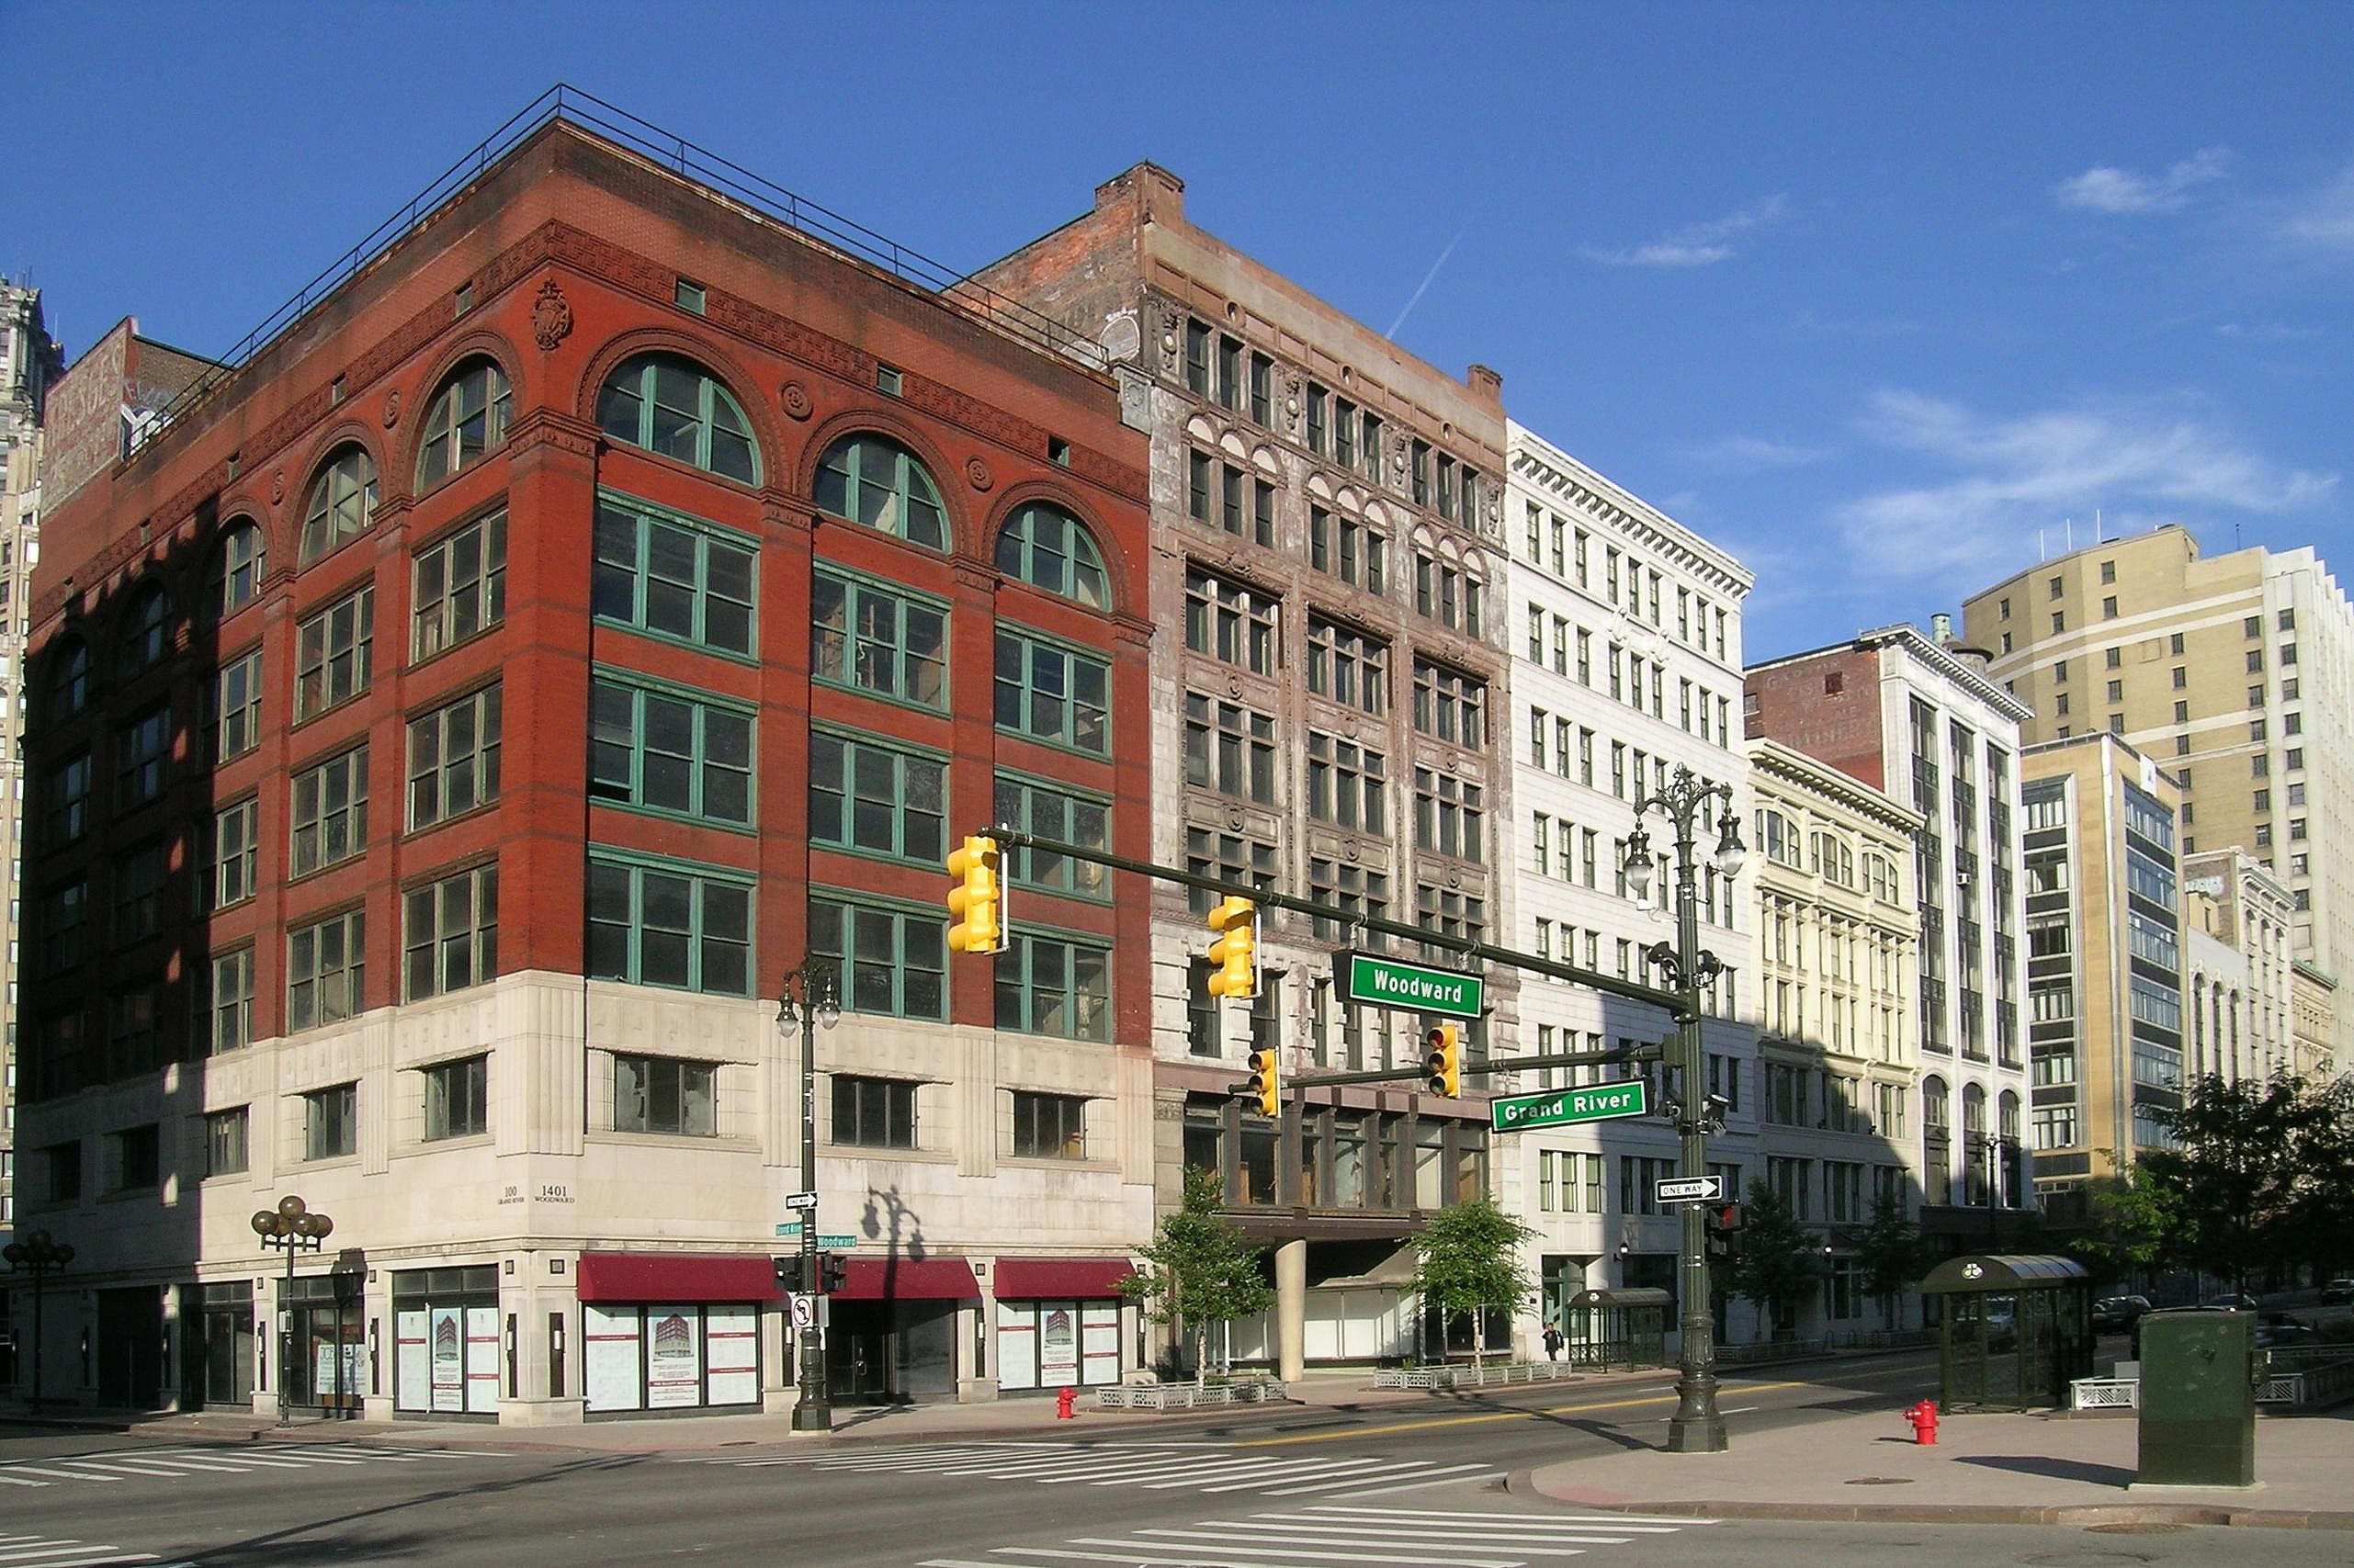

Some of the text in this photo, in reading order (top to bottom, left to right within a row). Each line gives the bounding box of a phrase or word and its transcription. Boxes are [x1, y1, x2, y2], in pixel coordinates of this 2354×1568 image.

[1374, 969, 1462, 1003] Woodward
[1505, 1093, 1632, 1121] Grand River
[542, 1185, 566, 1197] 1401
[1663, 1184, 1702, 1195] ONE WAY
[817, 1237, 856, 1247] Woodward
